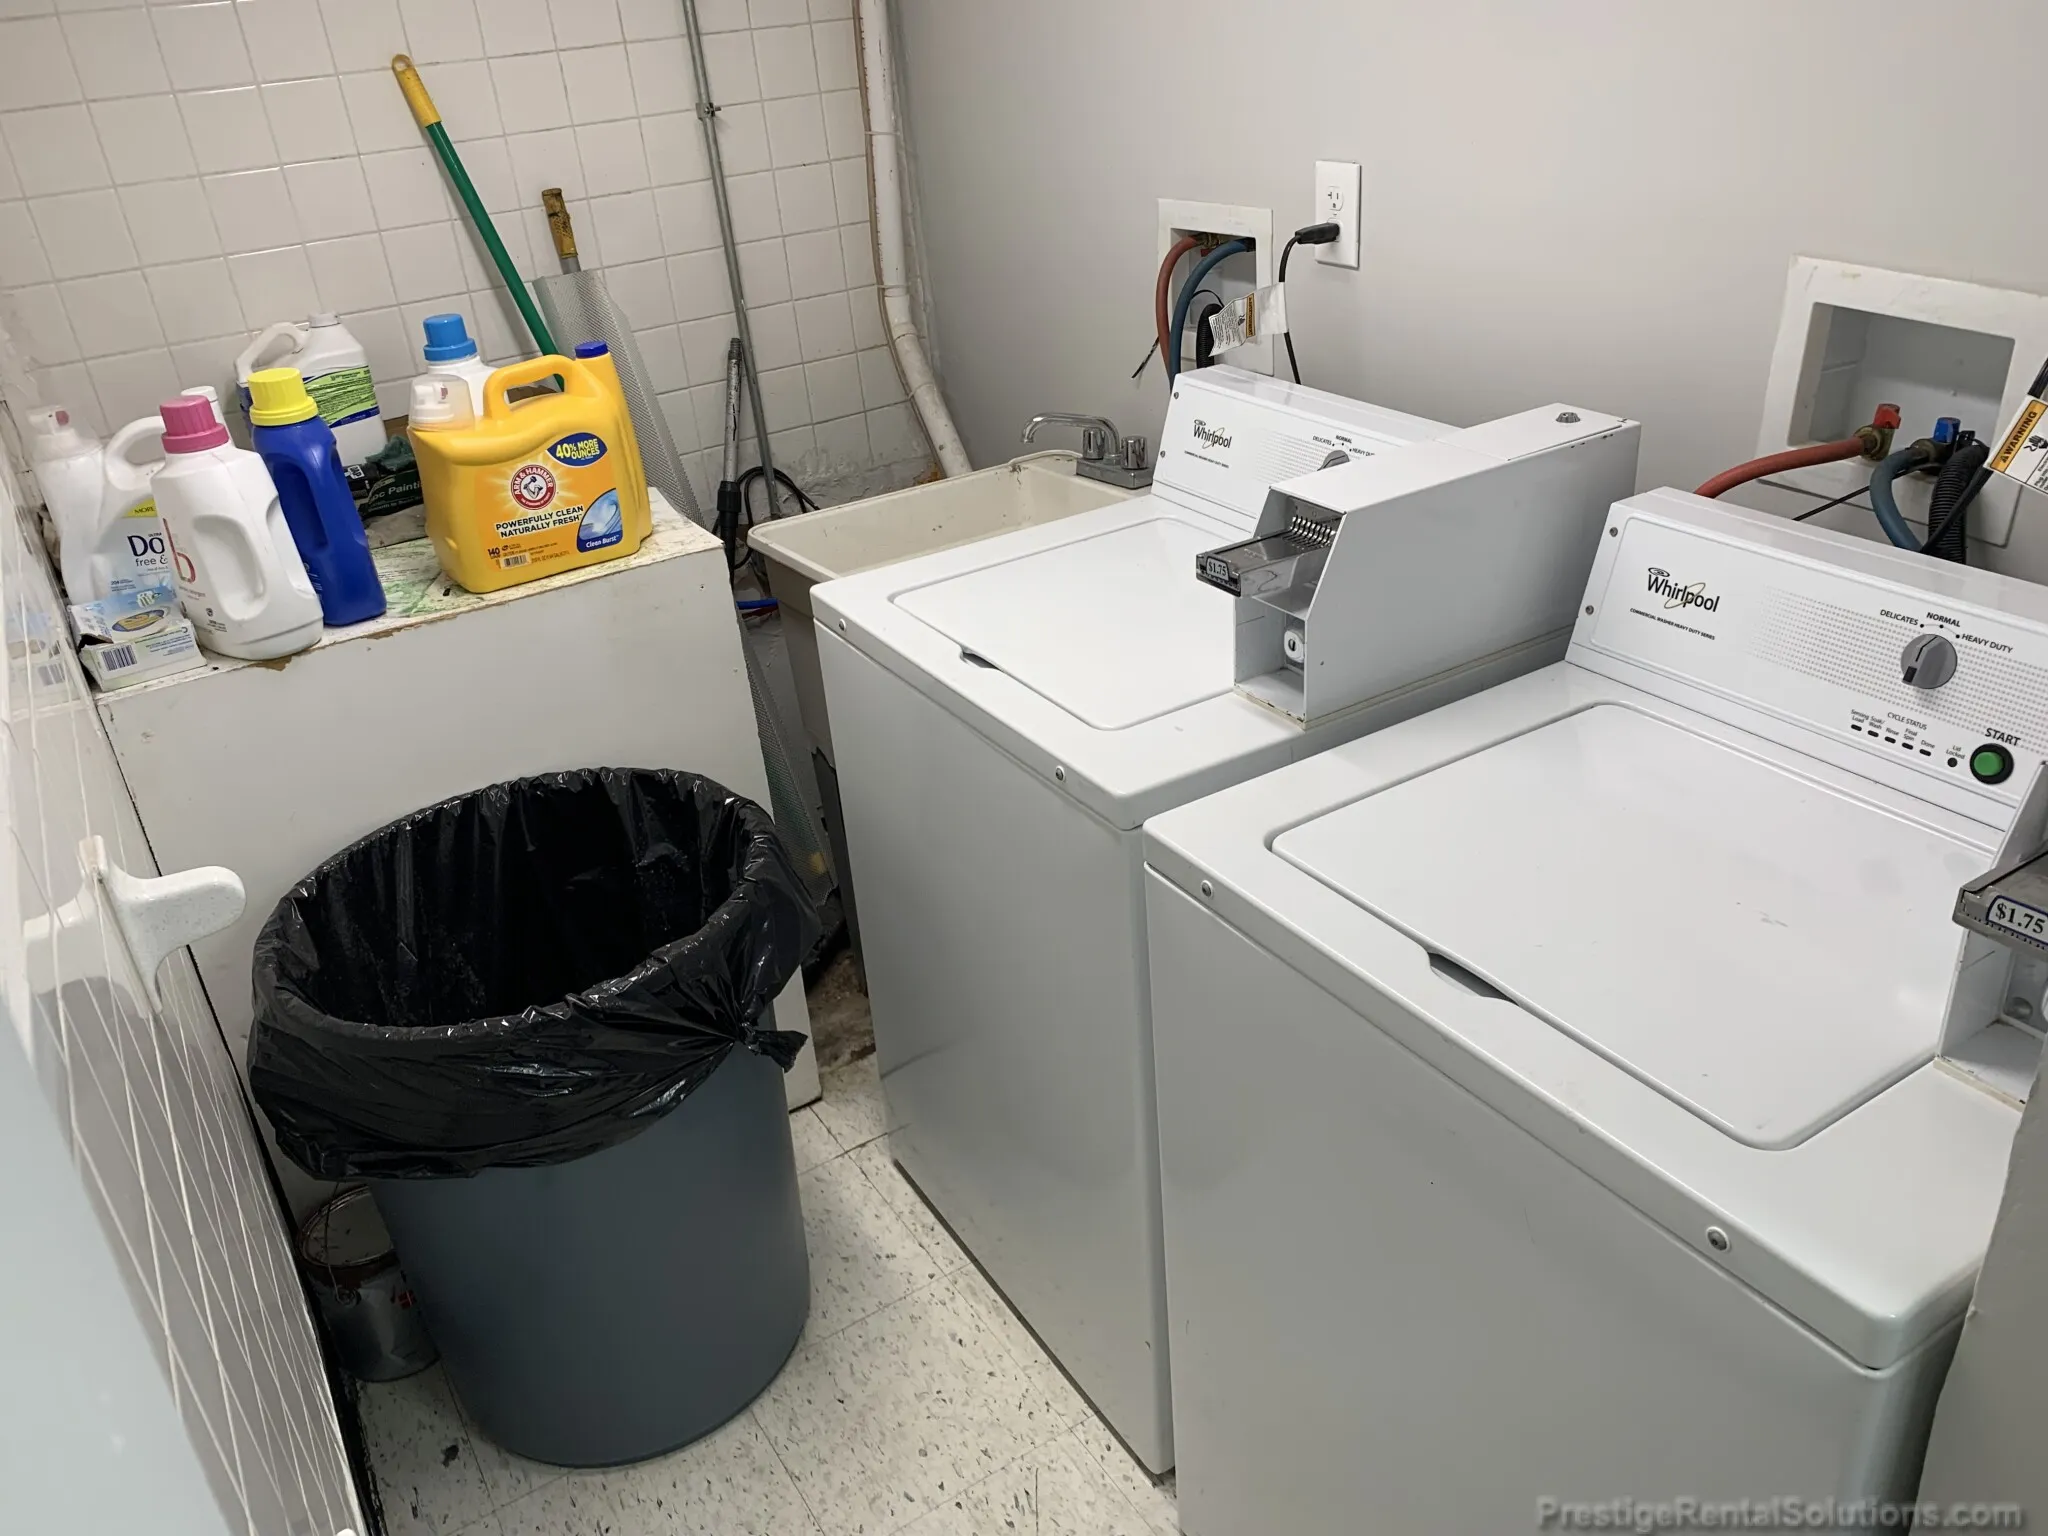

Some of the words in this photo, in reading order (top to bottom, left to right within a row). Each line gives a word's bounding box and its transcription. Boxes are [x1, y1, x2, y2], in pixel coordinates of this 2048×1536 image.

[1193, 424, 1232, 448] Whirlpool
[1312, 435, 1332, 446] DELICATES
[1335, 434, 1352, 444] NORMAL
[2004, 411, 2038, 456] WARNING
[577, 438, 598, 450] MORE
[571, 446, 600, 460] OUNCES
[513, 477, 522, 495] ARM
[525, 467, 554, 488] HAMMER
[495, 512, 553, 531] POWERFULLY
[556, 505, 584, 517] CLEAN
[500, 522, 551, 538] NATURALLY
[585, 540, 602, 548] Clean
[135, 557, 157, 567] free
[1208, 561, 1227, 577] $1.75
[1647, 573, 1720, 612] Whirlpool
[1629, 608, 1657, 621] COMMERCIAL
[1674, 622, 1688, 631] HEAVY
[1688, 627, 1701, 635] DUTY
[1700, 631, 1715, 641] SERIES
[1880, 609, 1919, 626] DELICATES
[1926, 612, 1961, 628] NORMAL
[1961, 633, 1989, 647] HEAVY
[1990, 641, 2013, 654] DUTY
[1851, 709, 1869, 720] Sensing
[1852, 715, 1865, 723] Load
[1887, 711, 1906, 723] CYCLE
[1905, 718, 1928, 731] STATUS
[1869, 721, 1882, 730] Wash
[1886, 727, 1900, 736] Rinse
[1905, 728, 1918, 736] Final
[1903, 733, 1915, 741] Spin
[1920, 740, 1935, 749] Done
[1984, 727, 2021, 747] START
[1946, 749, 1965, 760] Locked
[1995, 902, 2046, 935] $1.75
